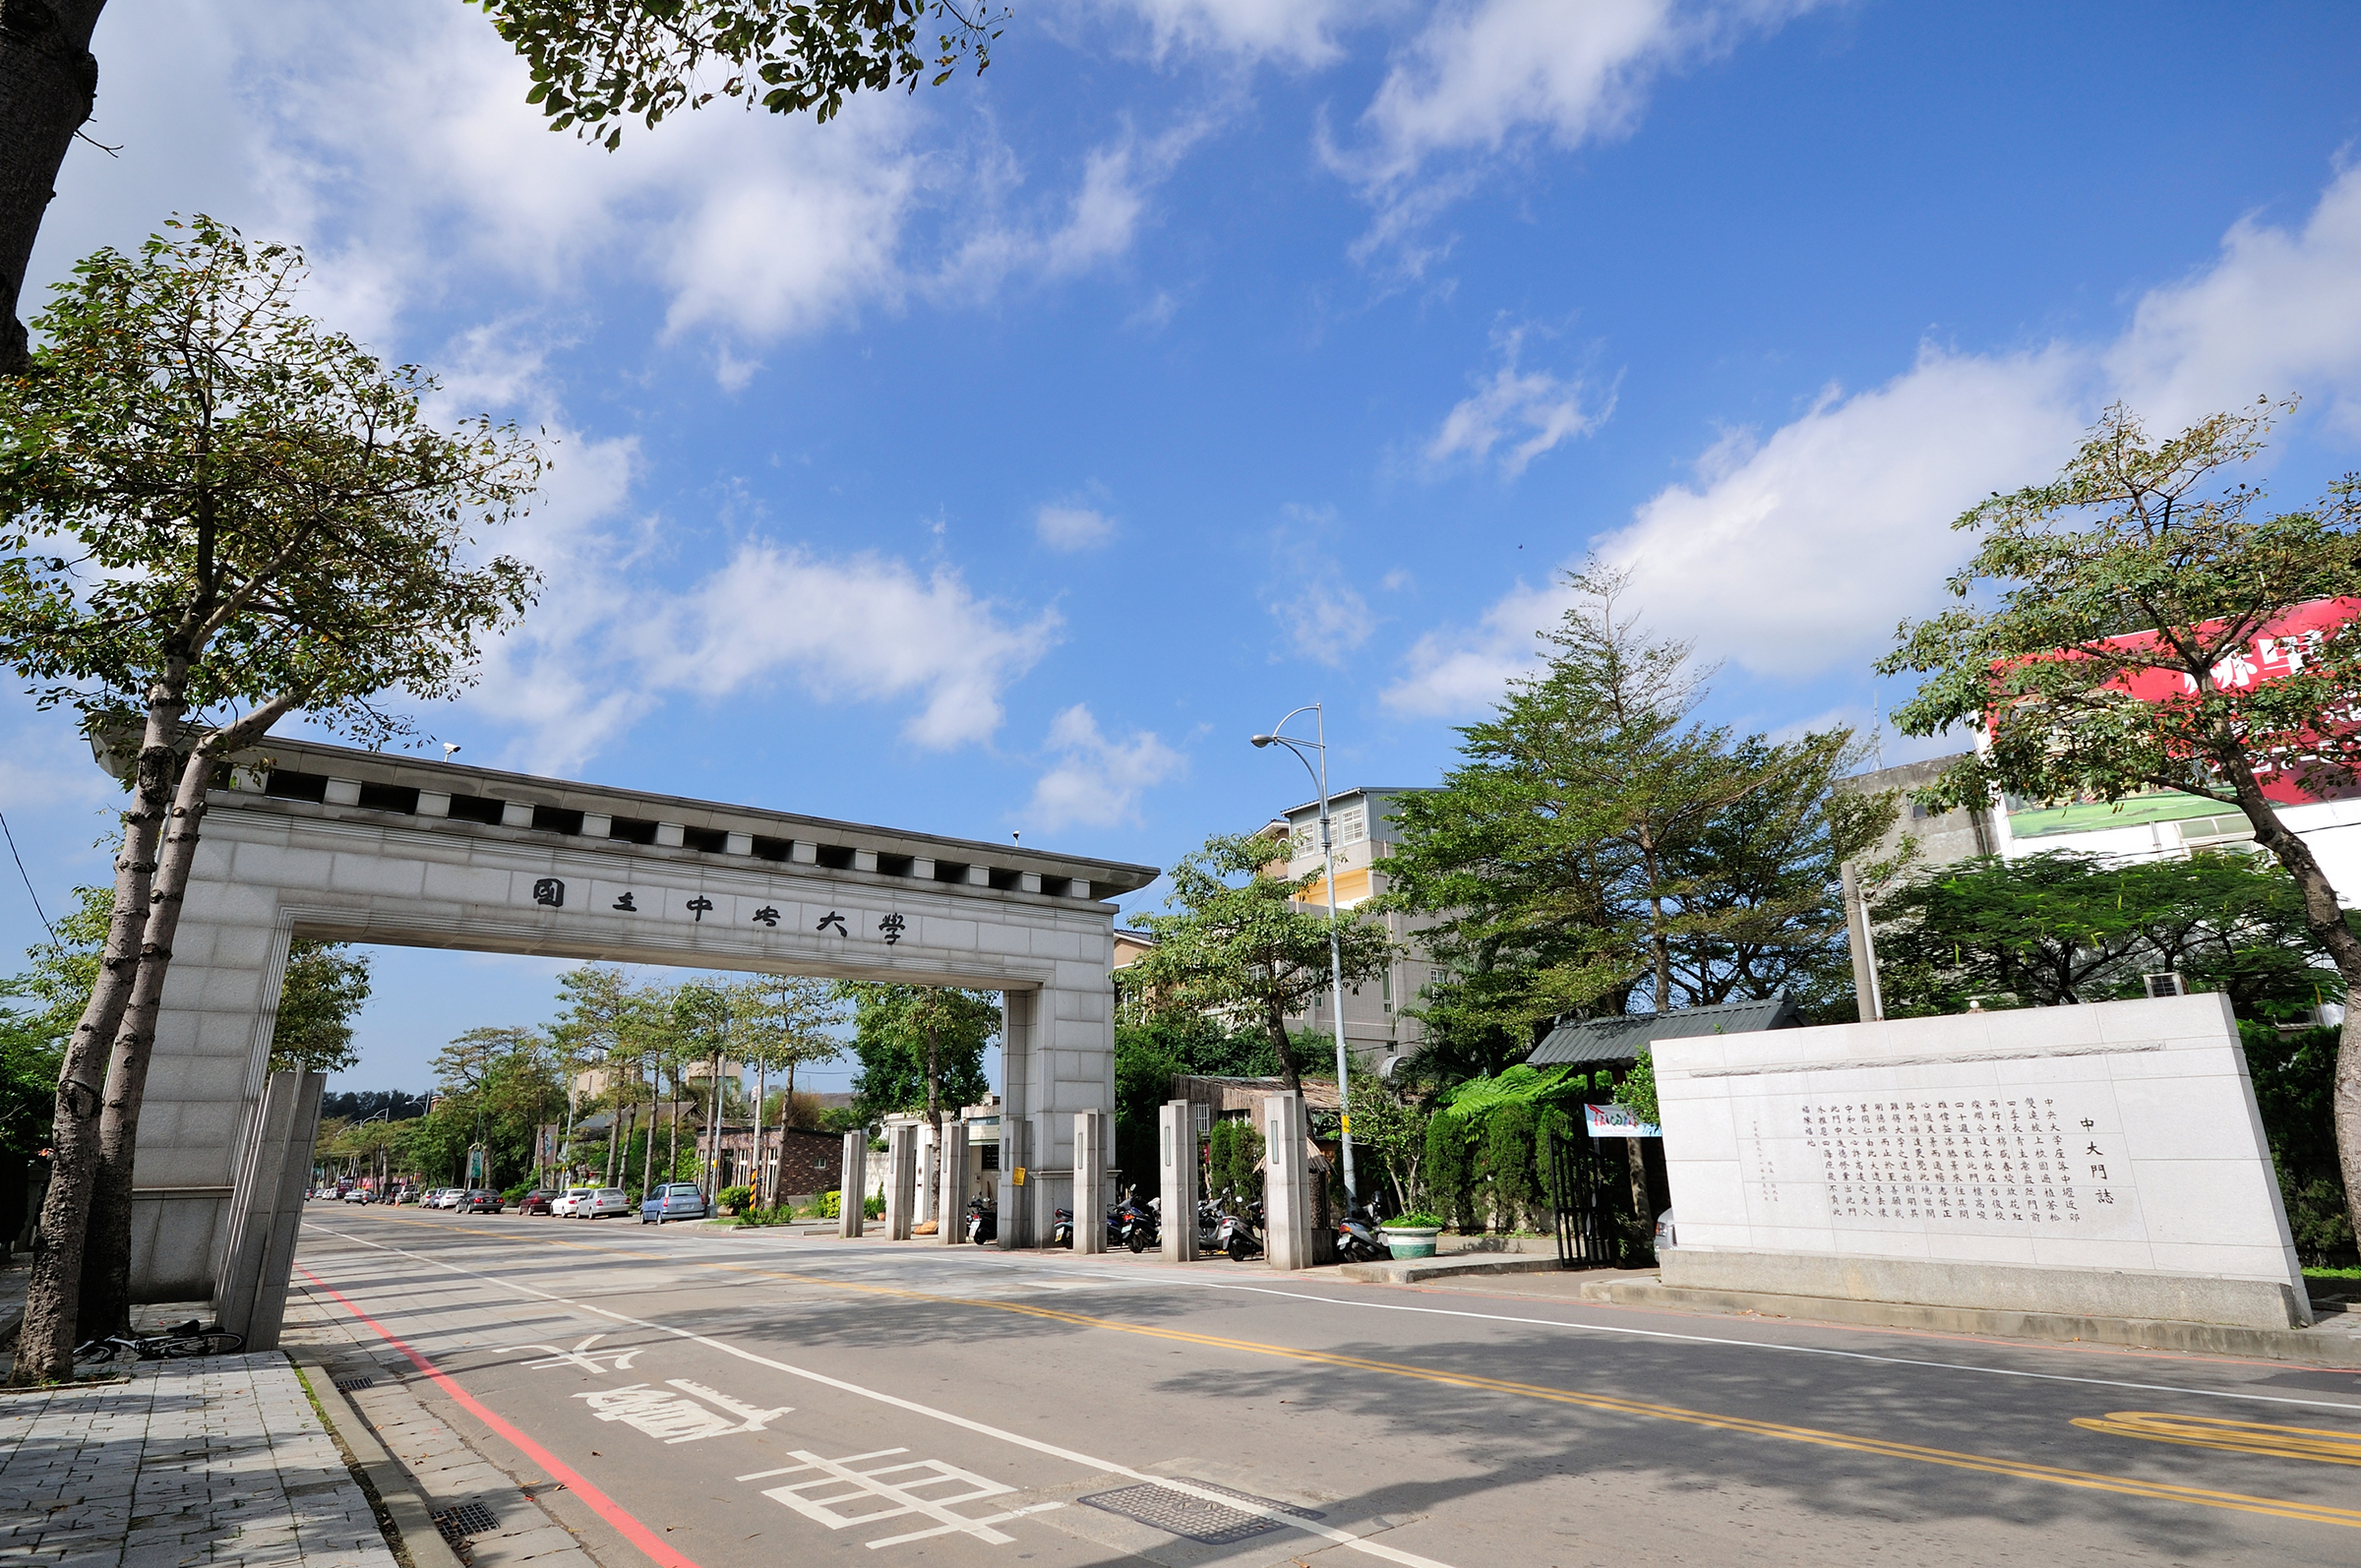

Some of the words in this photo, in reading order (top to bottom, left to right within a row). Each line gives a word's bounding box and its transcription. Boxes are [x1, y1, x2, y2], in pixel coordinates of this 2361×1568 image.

[533, 877, 906, 945] 國立中央大學
[2080, 1116, 2115, 1205] 中大門誌
